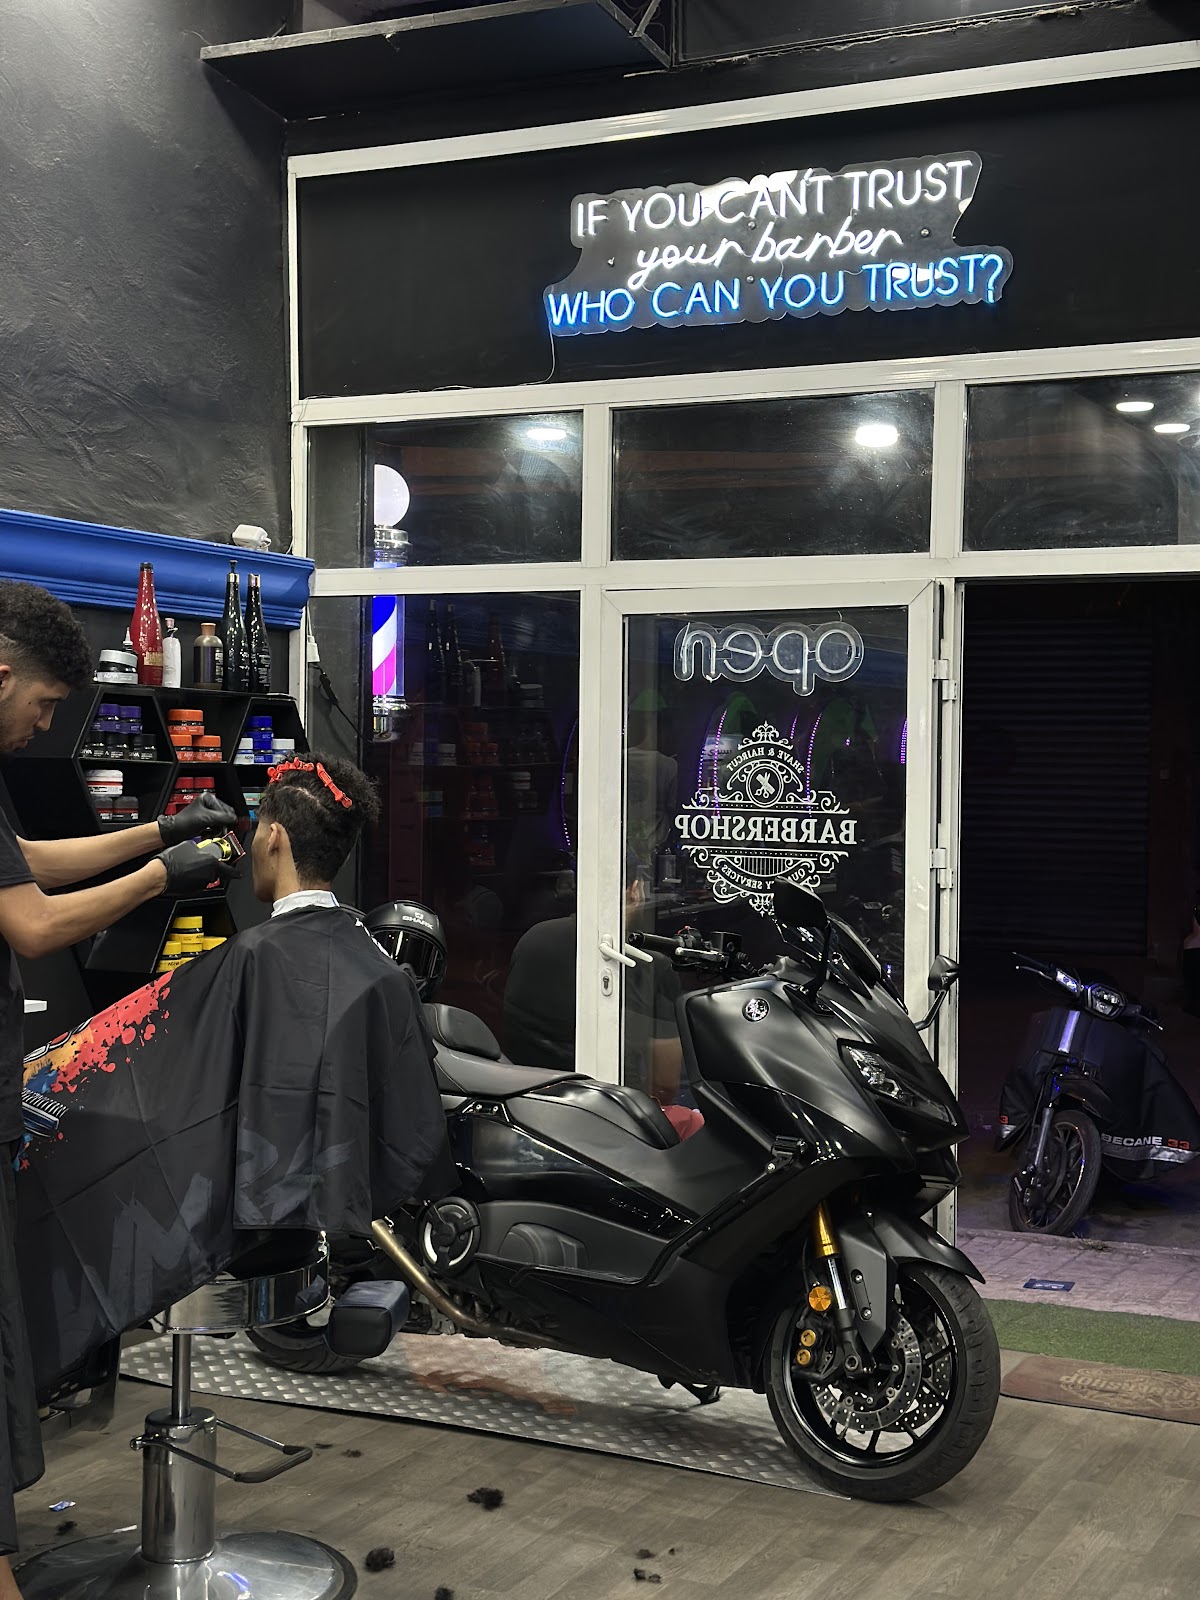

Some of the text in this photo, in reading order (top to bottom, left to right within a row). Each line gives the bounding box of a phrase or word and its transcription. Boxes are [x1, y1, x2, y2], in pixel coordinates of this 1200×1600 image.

[576, 160, 973, 237] IF YOU CAN'T TRUST
[547, 252, 1004, 328] WHO CAN YOU TRUST?
[627, 216, 904, 290] your barber
[1101, 1133, 1190, 1150] BECANE 33
